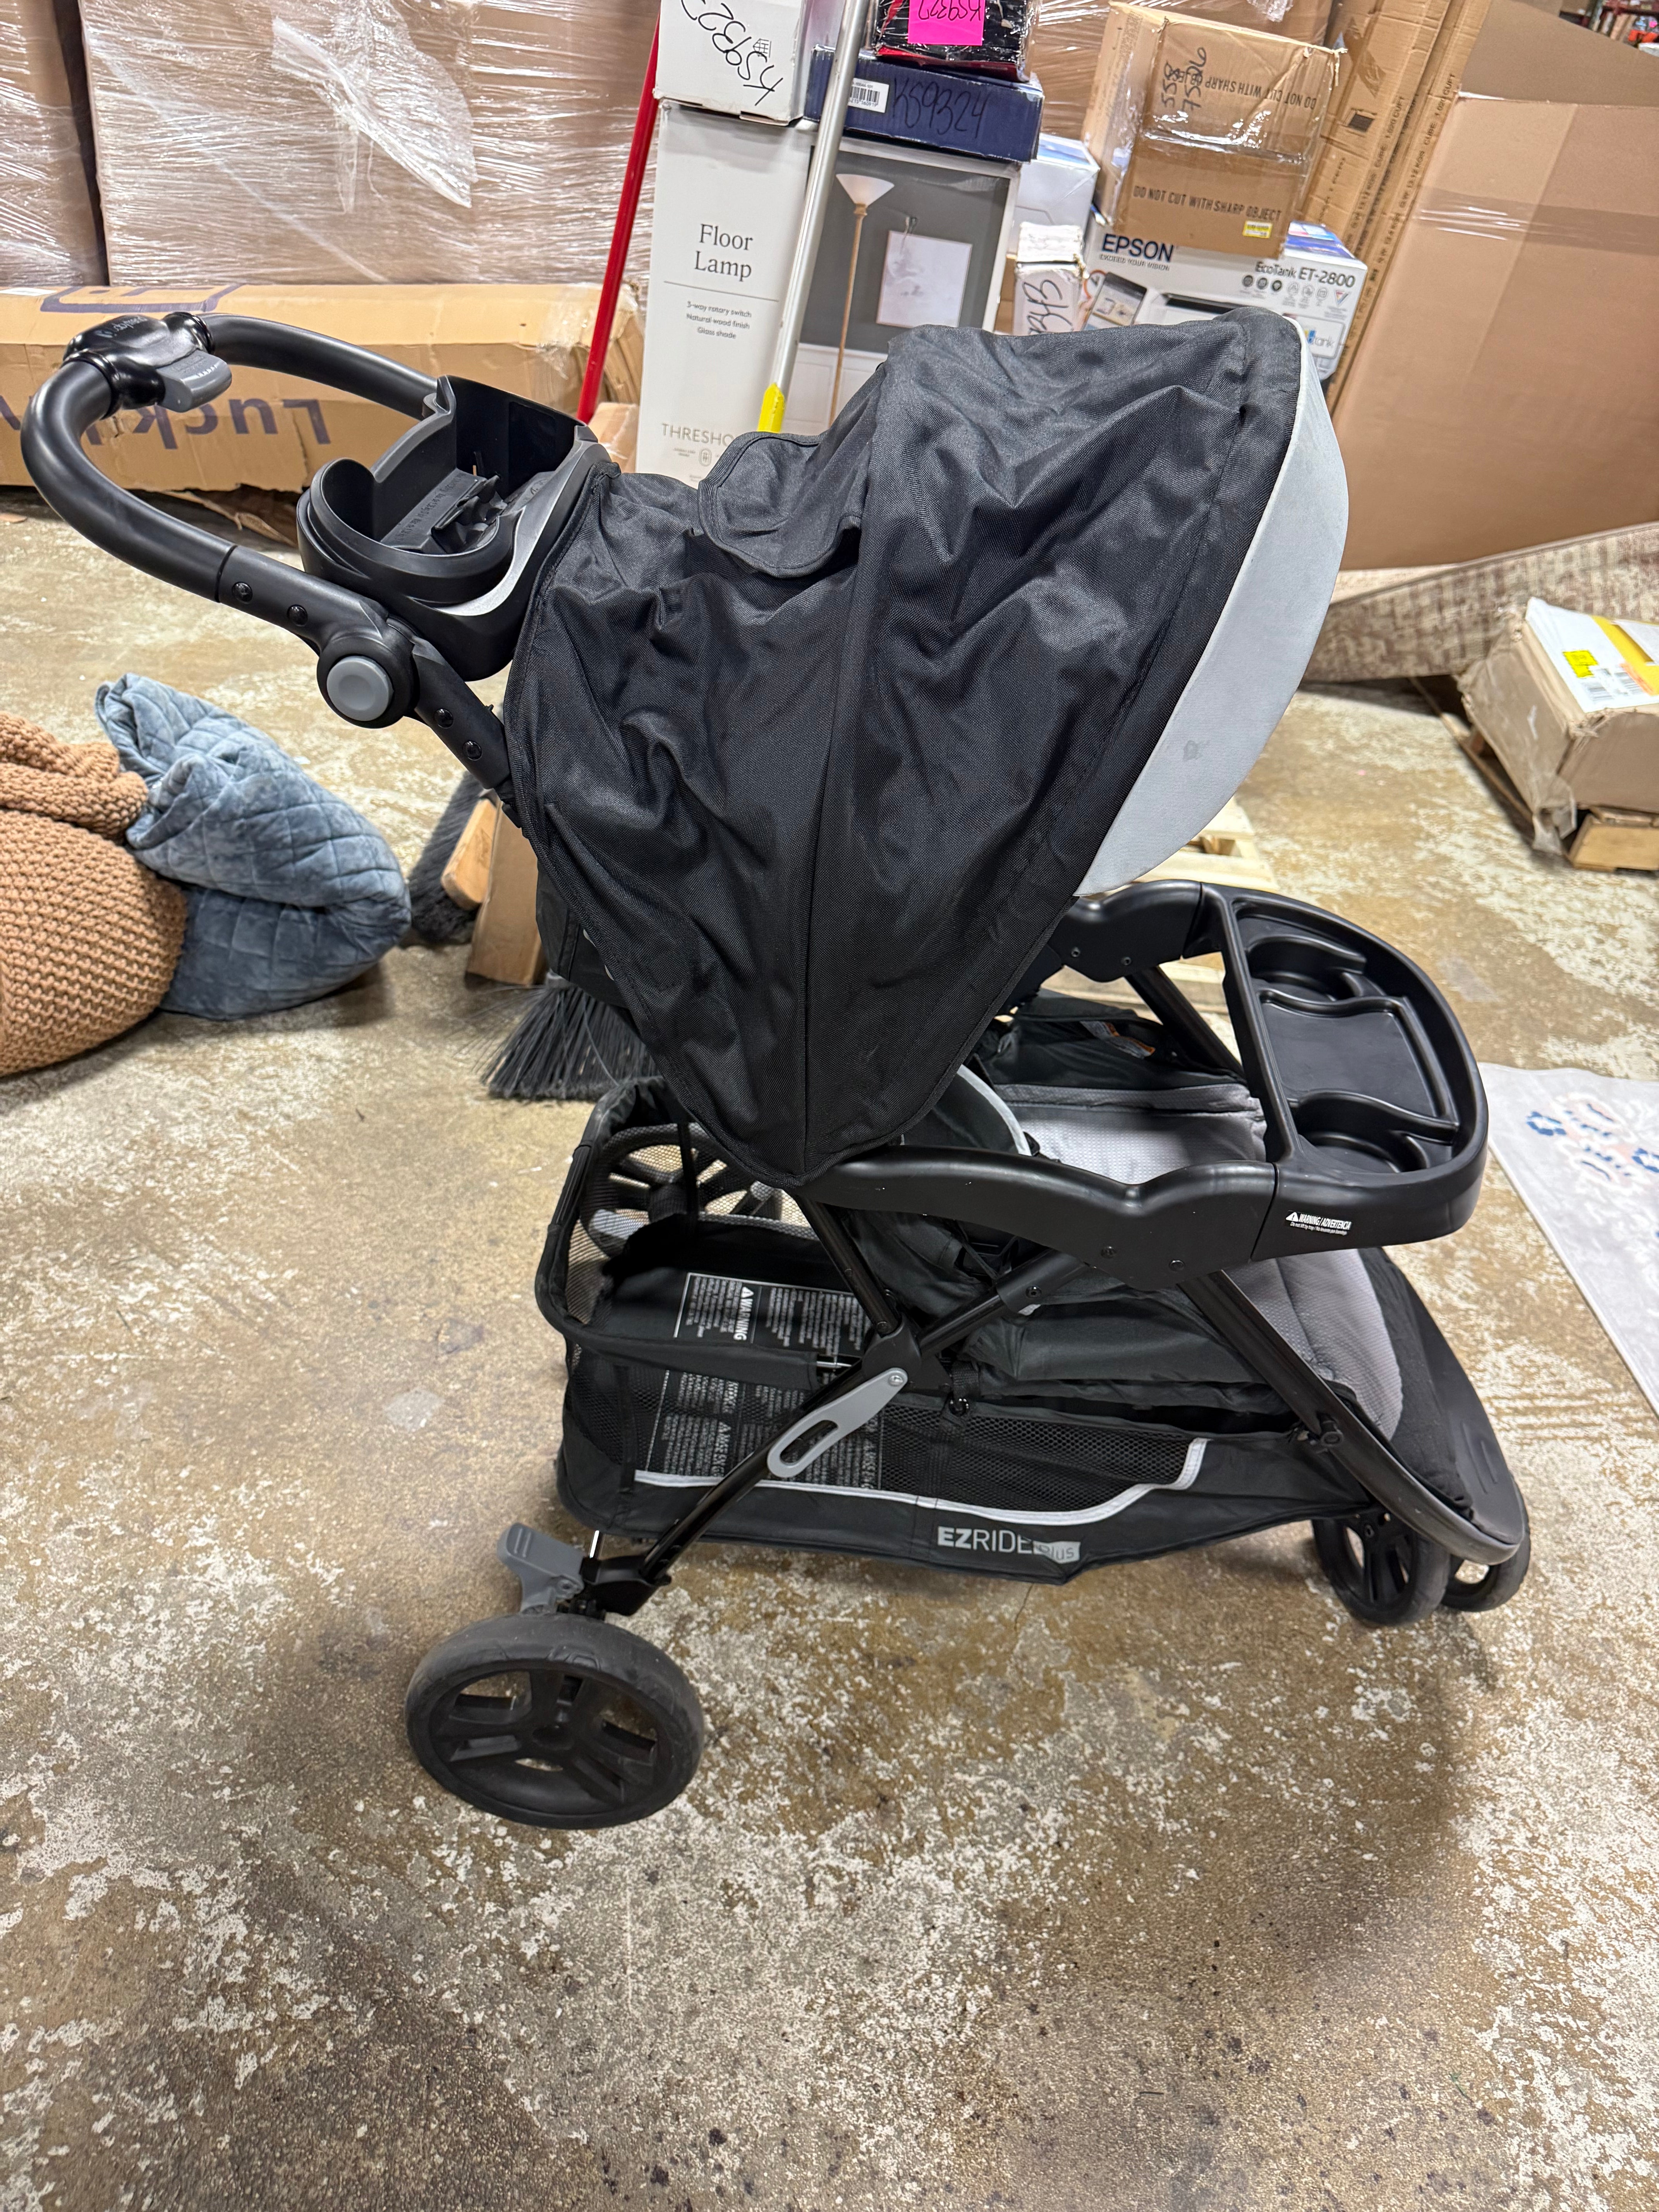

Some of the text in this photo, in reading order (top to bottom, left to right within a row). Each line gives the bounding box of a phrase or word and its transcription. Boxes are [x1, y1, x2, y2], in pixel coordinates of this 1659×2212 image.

[1204, 76, 1236, 93] SHARP
[1238, 86, 1262, 98] WITH
[1285, 90, 1302, 106] NOT
[892, 77, 990, 139] KS9324
[1305, 96, 1317, 110] DO
[1148, 188, 1167, 201] NOT
[1168, 191, 1187, 206] CUT
[1188, 195, 1213, 211] WITH
[1213, 200, 1245, 215] SHARP
[1245, 205, 1282, 221] OBJECT
[699, 223, 753, 251] Floor
[1102, 233, 1174, 262] EPSON
[694, 250, 752, 282] Lamp
[1255, 261, 1297, 278] EcoTank
[1298, 266, 1356, 288] ET-2800
[686, 313, 750, 329] Natural wood finish
[708, 305, 729, 316] rotary
[731, 309, 752, 318] switch
[697, 326, 737, 339] Glass shade
[733, 1298, 753, 1341] WARNING
[937, 1525, 1032, 1555] EZRIDE
